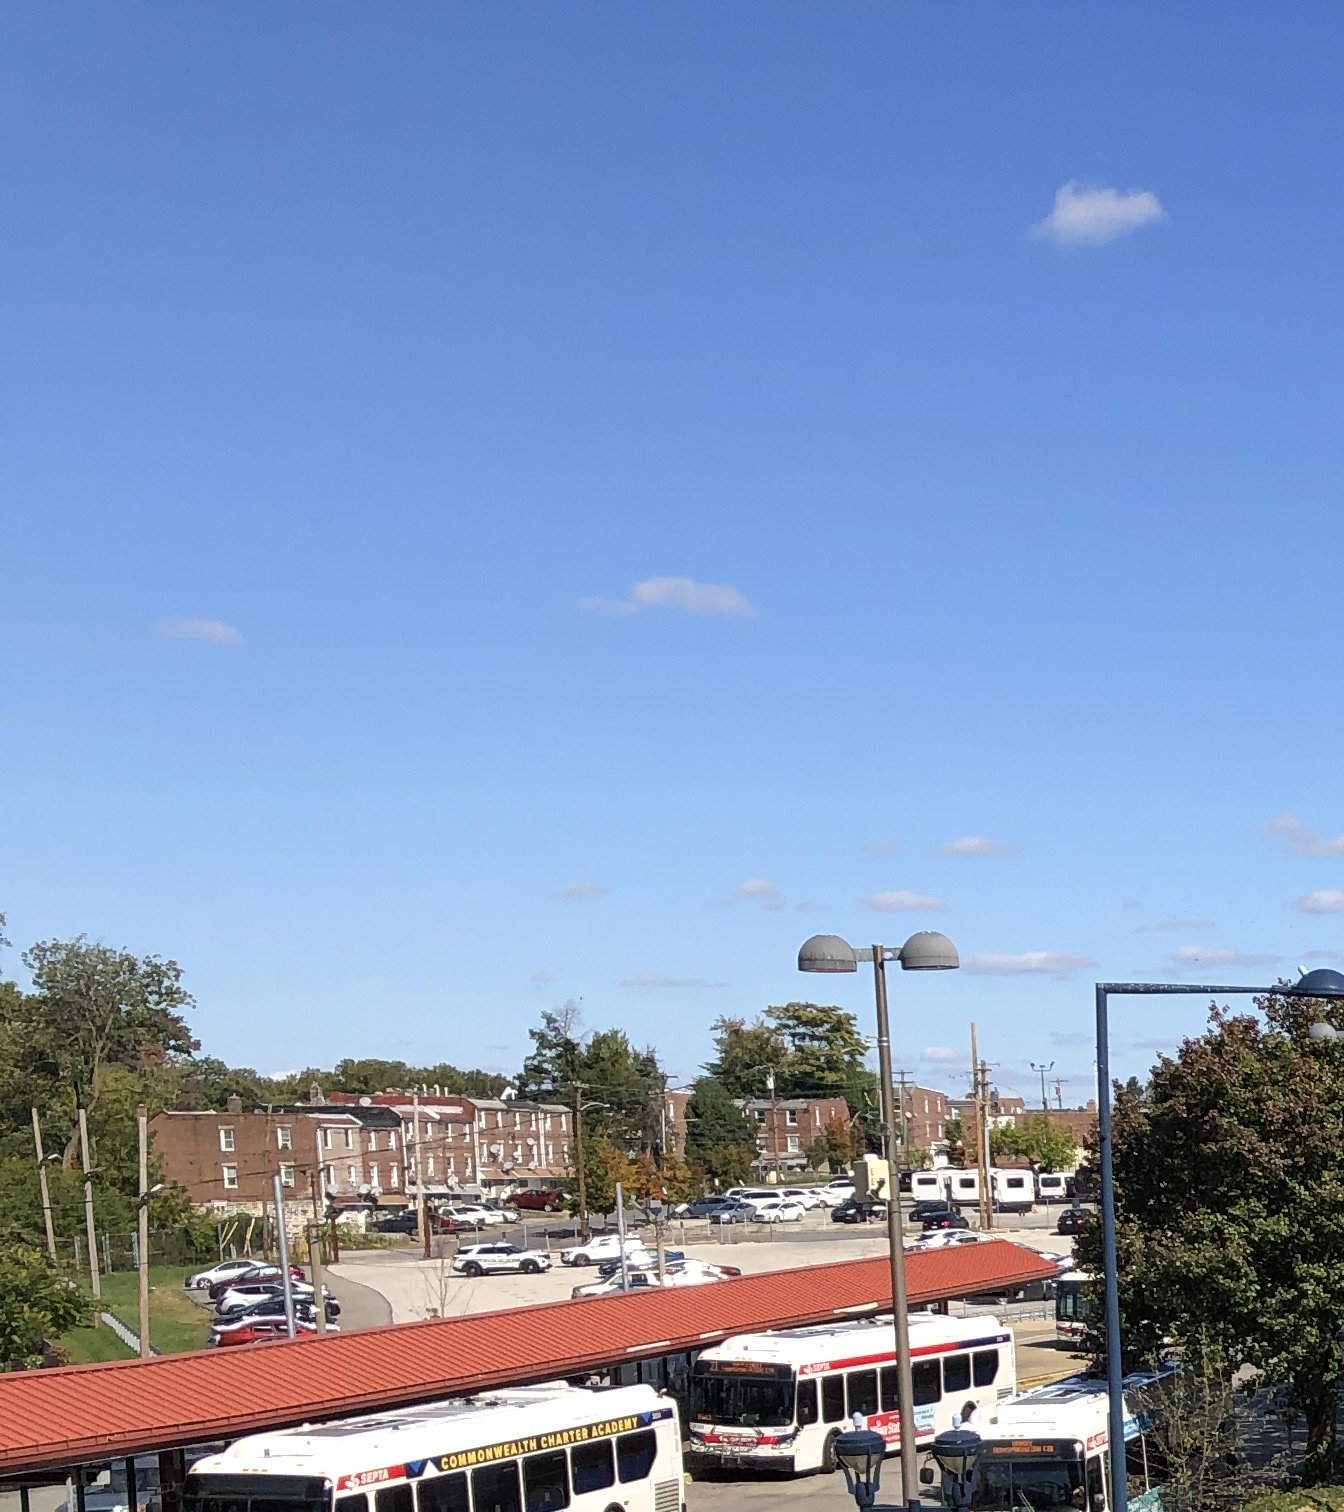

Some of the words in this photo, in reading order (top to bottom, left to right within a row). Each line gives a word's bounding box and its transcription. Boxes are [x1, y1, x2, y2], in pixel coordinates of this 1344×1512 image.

[441, 1438, 538, 1471] COMMONWEALTH
[541, 1427, 589, 1449] CHARTER
[591, 1416, 639, 1438] ACADEMY
[361, 1468, 389, 1485] SEPTA
